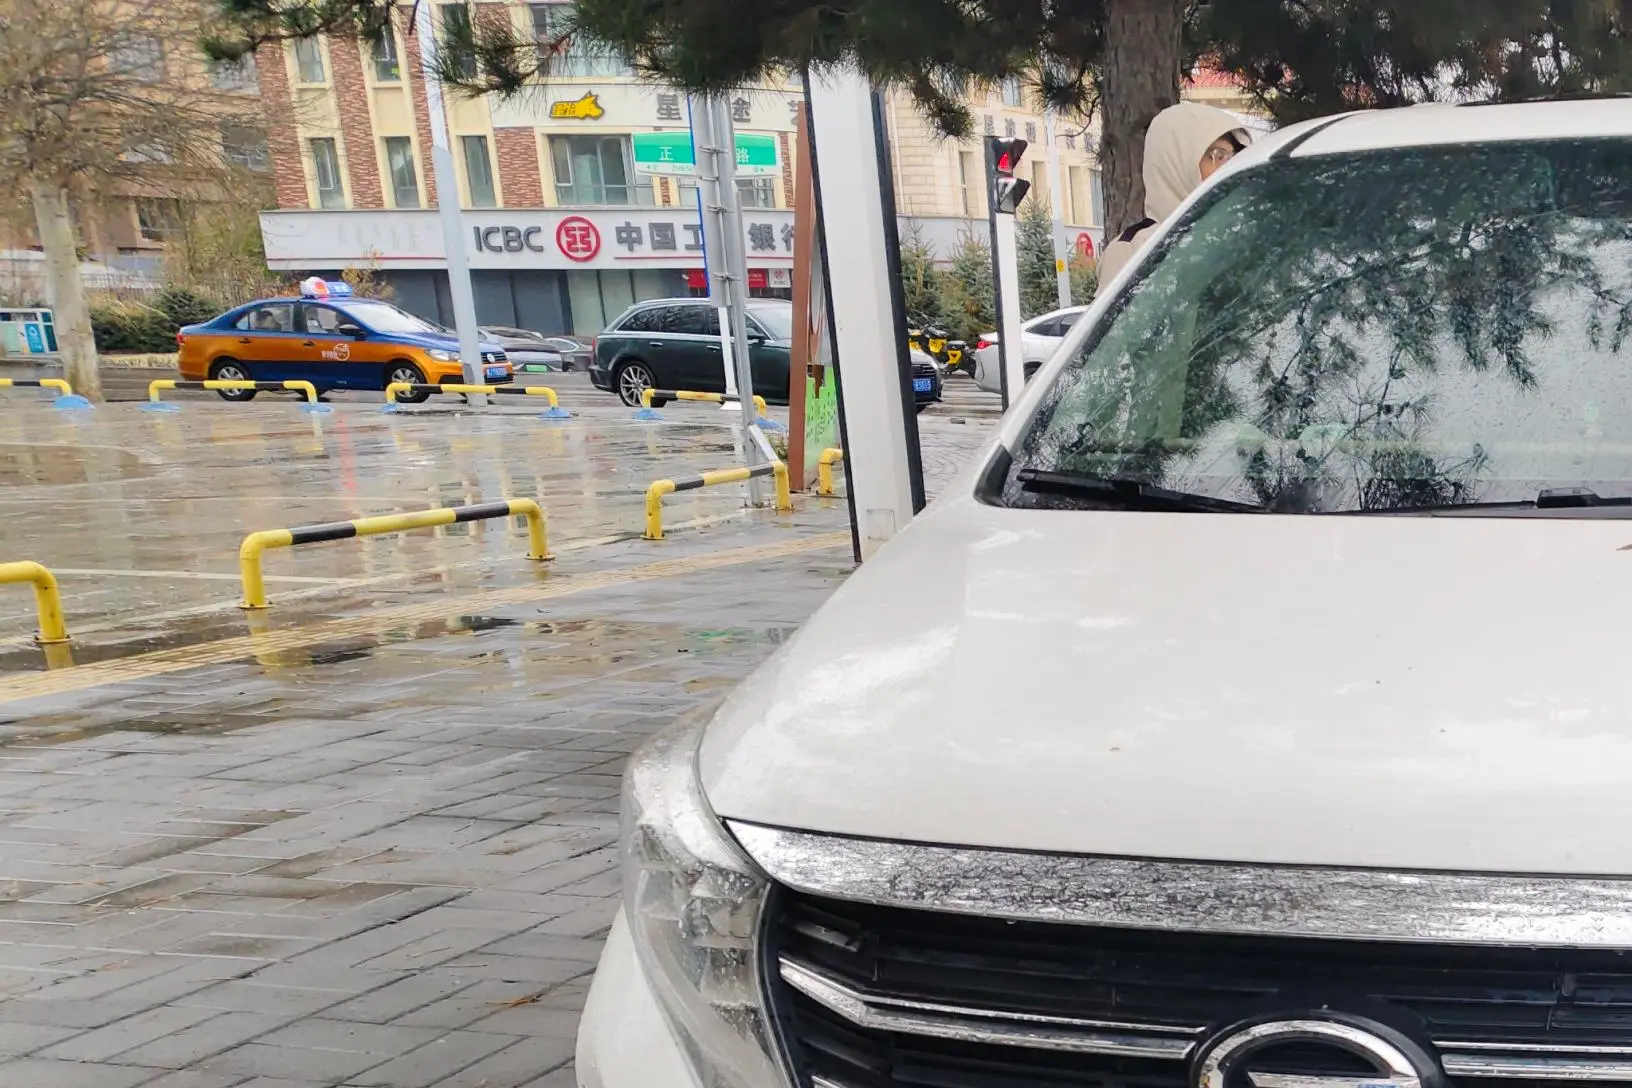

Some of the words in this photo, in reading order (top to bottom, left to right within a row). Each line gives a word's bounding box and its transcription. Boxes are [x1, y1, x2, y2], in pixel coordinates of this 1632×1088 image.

[473, 225, 544, 253] ICBC
[615, 221, 794, 252] 中国工银
